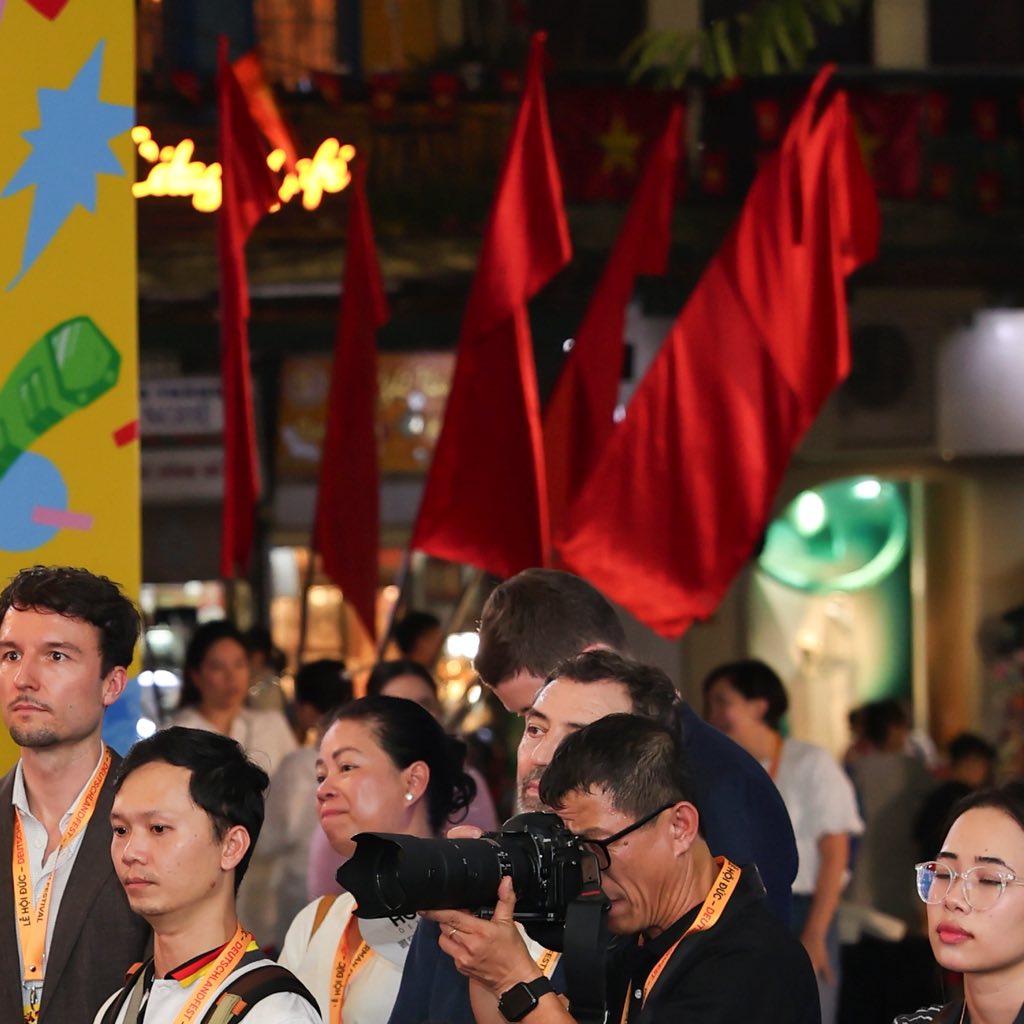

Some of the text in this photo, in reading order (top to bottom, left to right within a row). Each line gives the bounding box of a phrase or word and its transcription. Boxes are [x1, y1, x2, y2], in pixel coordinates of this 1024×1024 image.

[18, 874, 29, 894] ĐỨC
[20, 897, 30, 914] HỘI
[183, 941, 244, 1021] DEUTSCHLANDFEST
